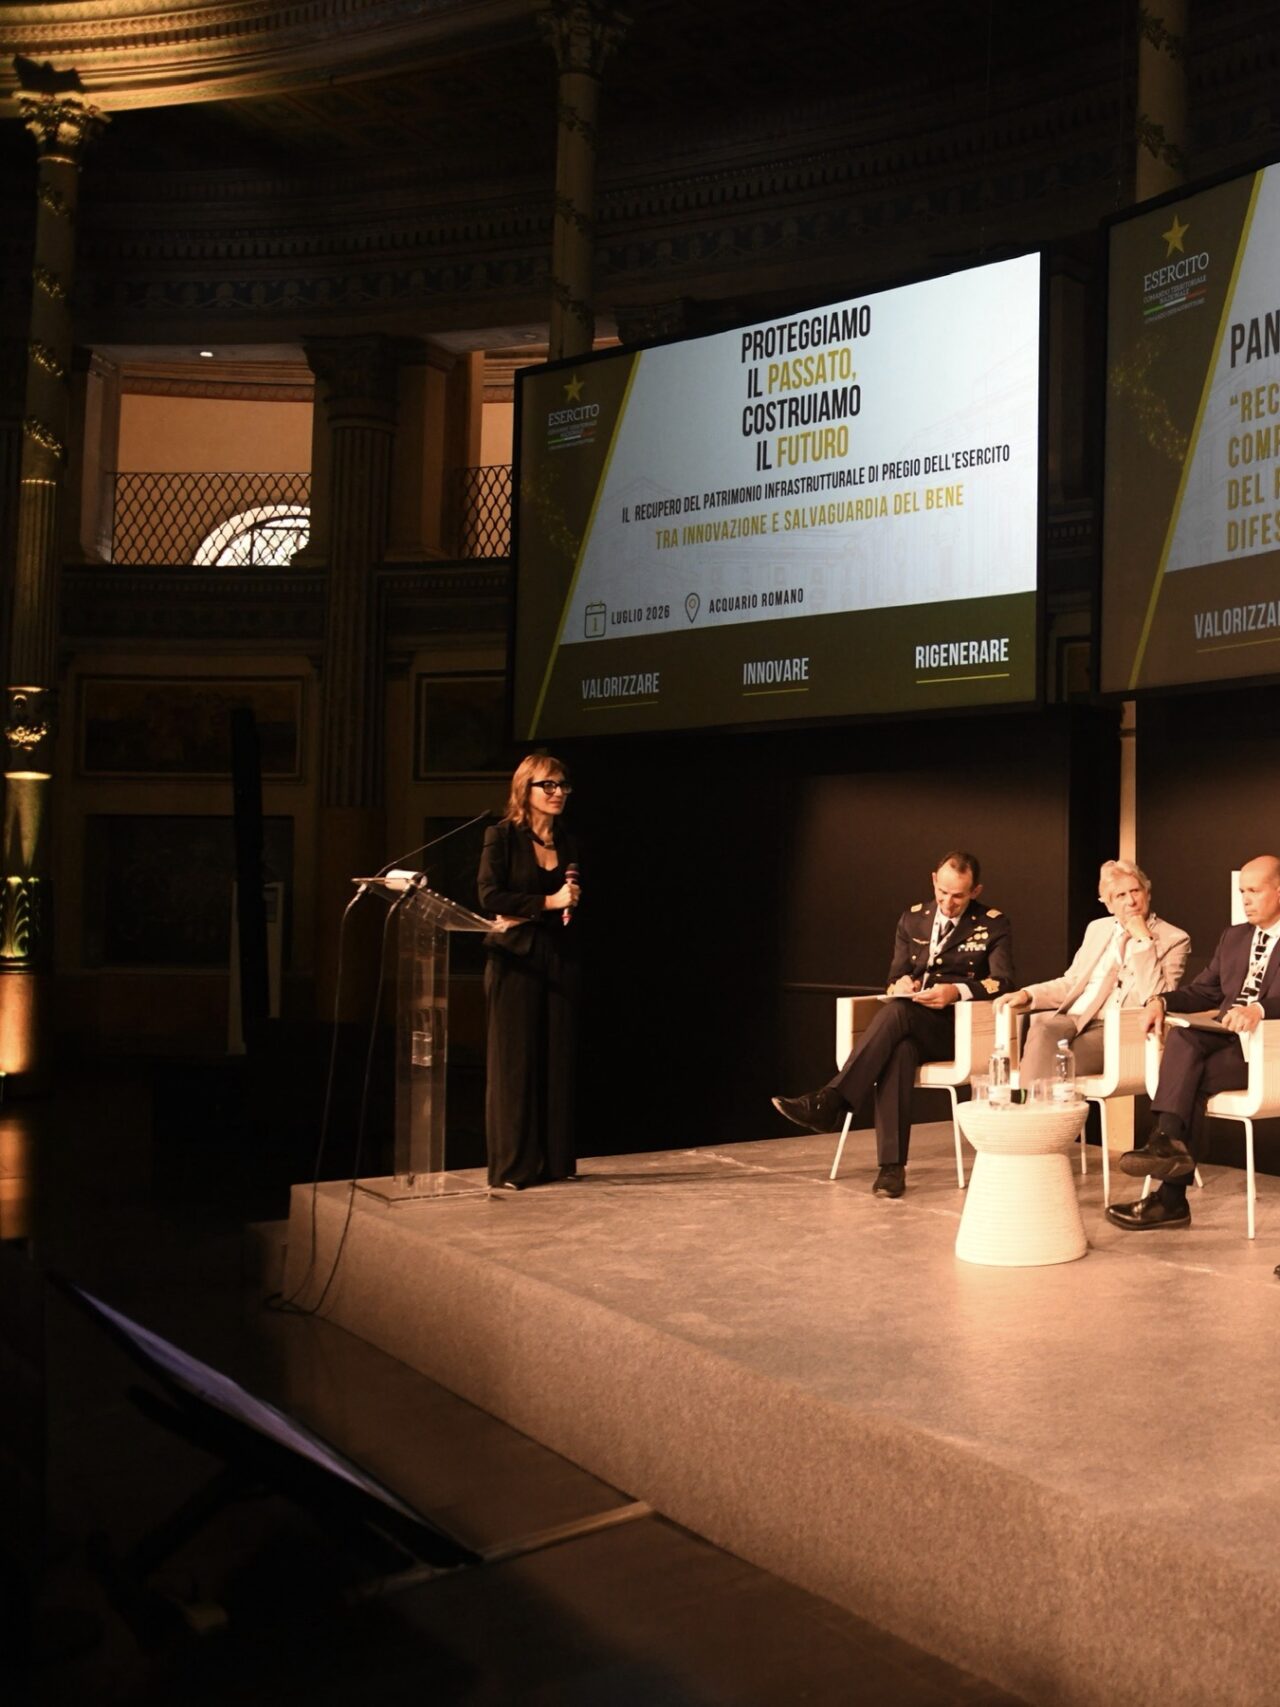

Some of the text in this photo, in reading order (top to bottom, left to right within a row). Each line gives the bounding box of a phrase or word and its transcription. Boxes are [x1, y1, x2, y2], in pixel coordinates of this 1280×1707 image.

[1144, 251, 1209, 292] ESERCITO
[741, 304, 871, 363] PROTEGGIAMO
[748, 348, 857, 399] IL PASSATO,
[548, 404, 600, 426] ESERCITO
[742, 384, 861, 437] COSTRUIAMO
[757, 425, 849, 471] IL FUTURO
[622, 444, 1010, 524] IL RECUPERO DEL PATRIMONIO INFRASTRUTTURALE DI PREGIO DELL'ESERCITO
[1227, 473, 1264, 511] DEL
[655, 484, 964, 550] TRA INNOVAZIONE E SALVAGUARDIA DEL BENE
[611, 608, 643, 625] LUGLIO
[645, 605, 670, 621] 2026
[708, 588, 804, 614] ACQUARIO ROMANO
[743, 657, 809, 685] INNOVARE
[914, 637, 1010, 669] RIGENERARE
[582, 672, 660, 700] VALORIZZARE
